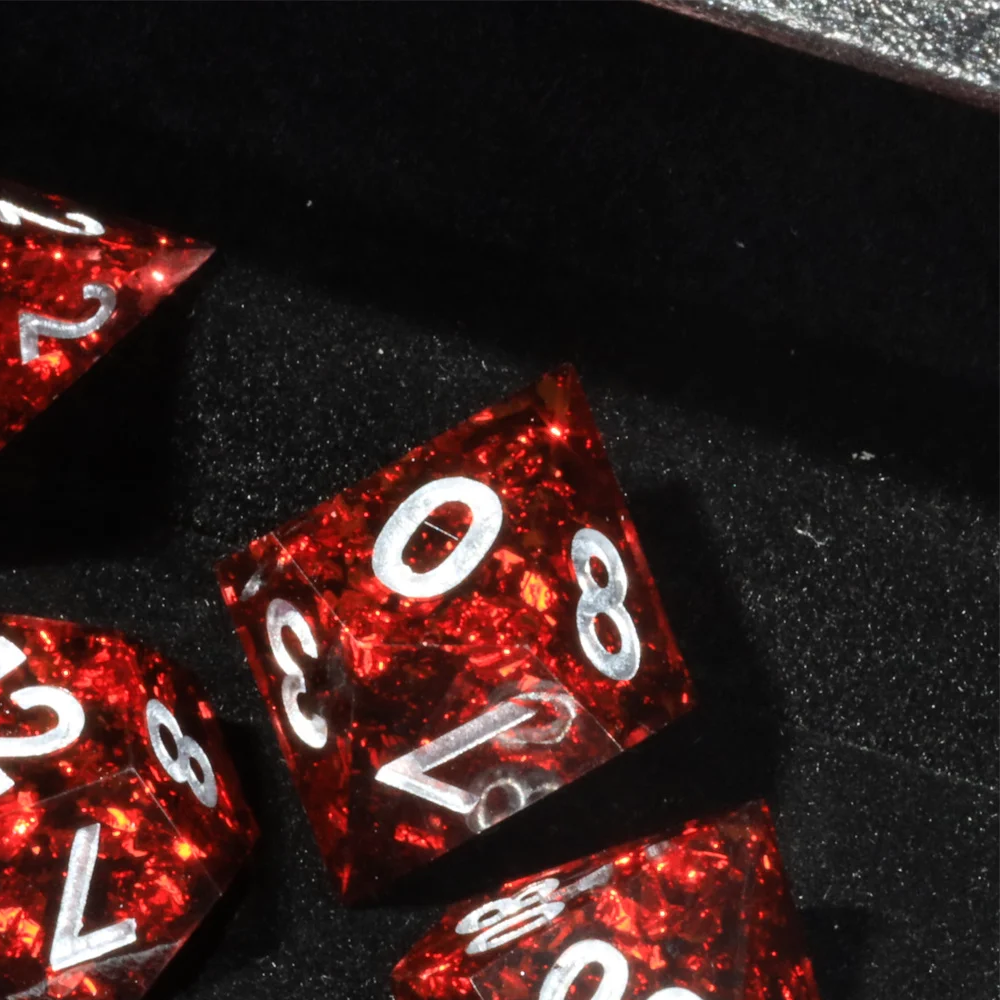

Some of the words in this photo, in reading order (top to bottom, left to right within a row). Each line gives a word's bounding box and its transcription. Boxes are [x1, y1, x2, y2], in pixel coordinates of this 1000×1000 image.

[17, 283, 117, 365] 2
[371, 476, 504, 599] 0
[571, 528, 641, 682] 8
[266, 599, 328, 748] 3
[146, 699, 218, 808] 8
[374, 697, 538, 815] 7
[50, 822, 137, 971] 7
